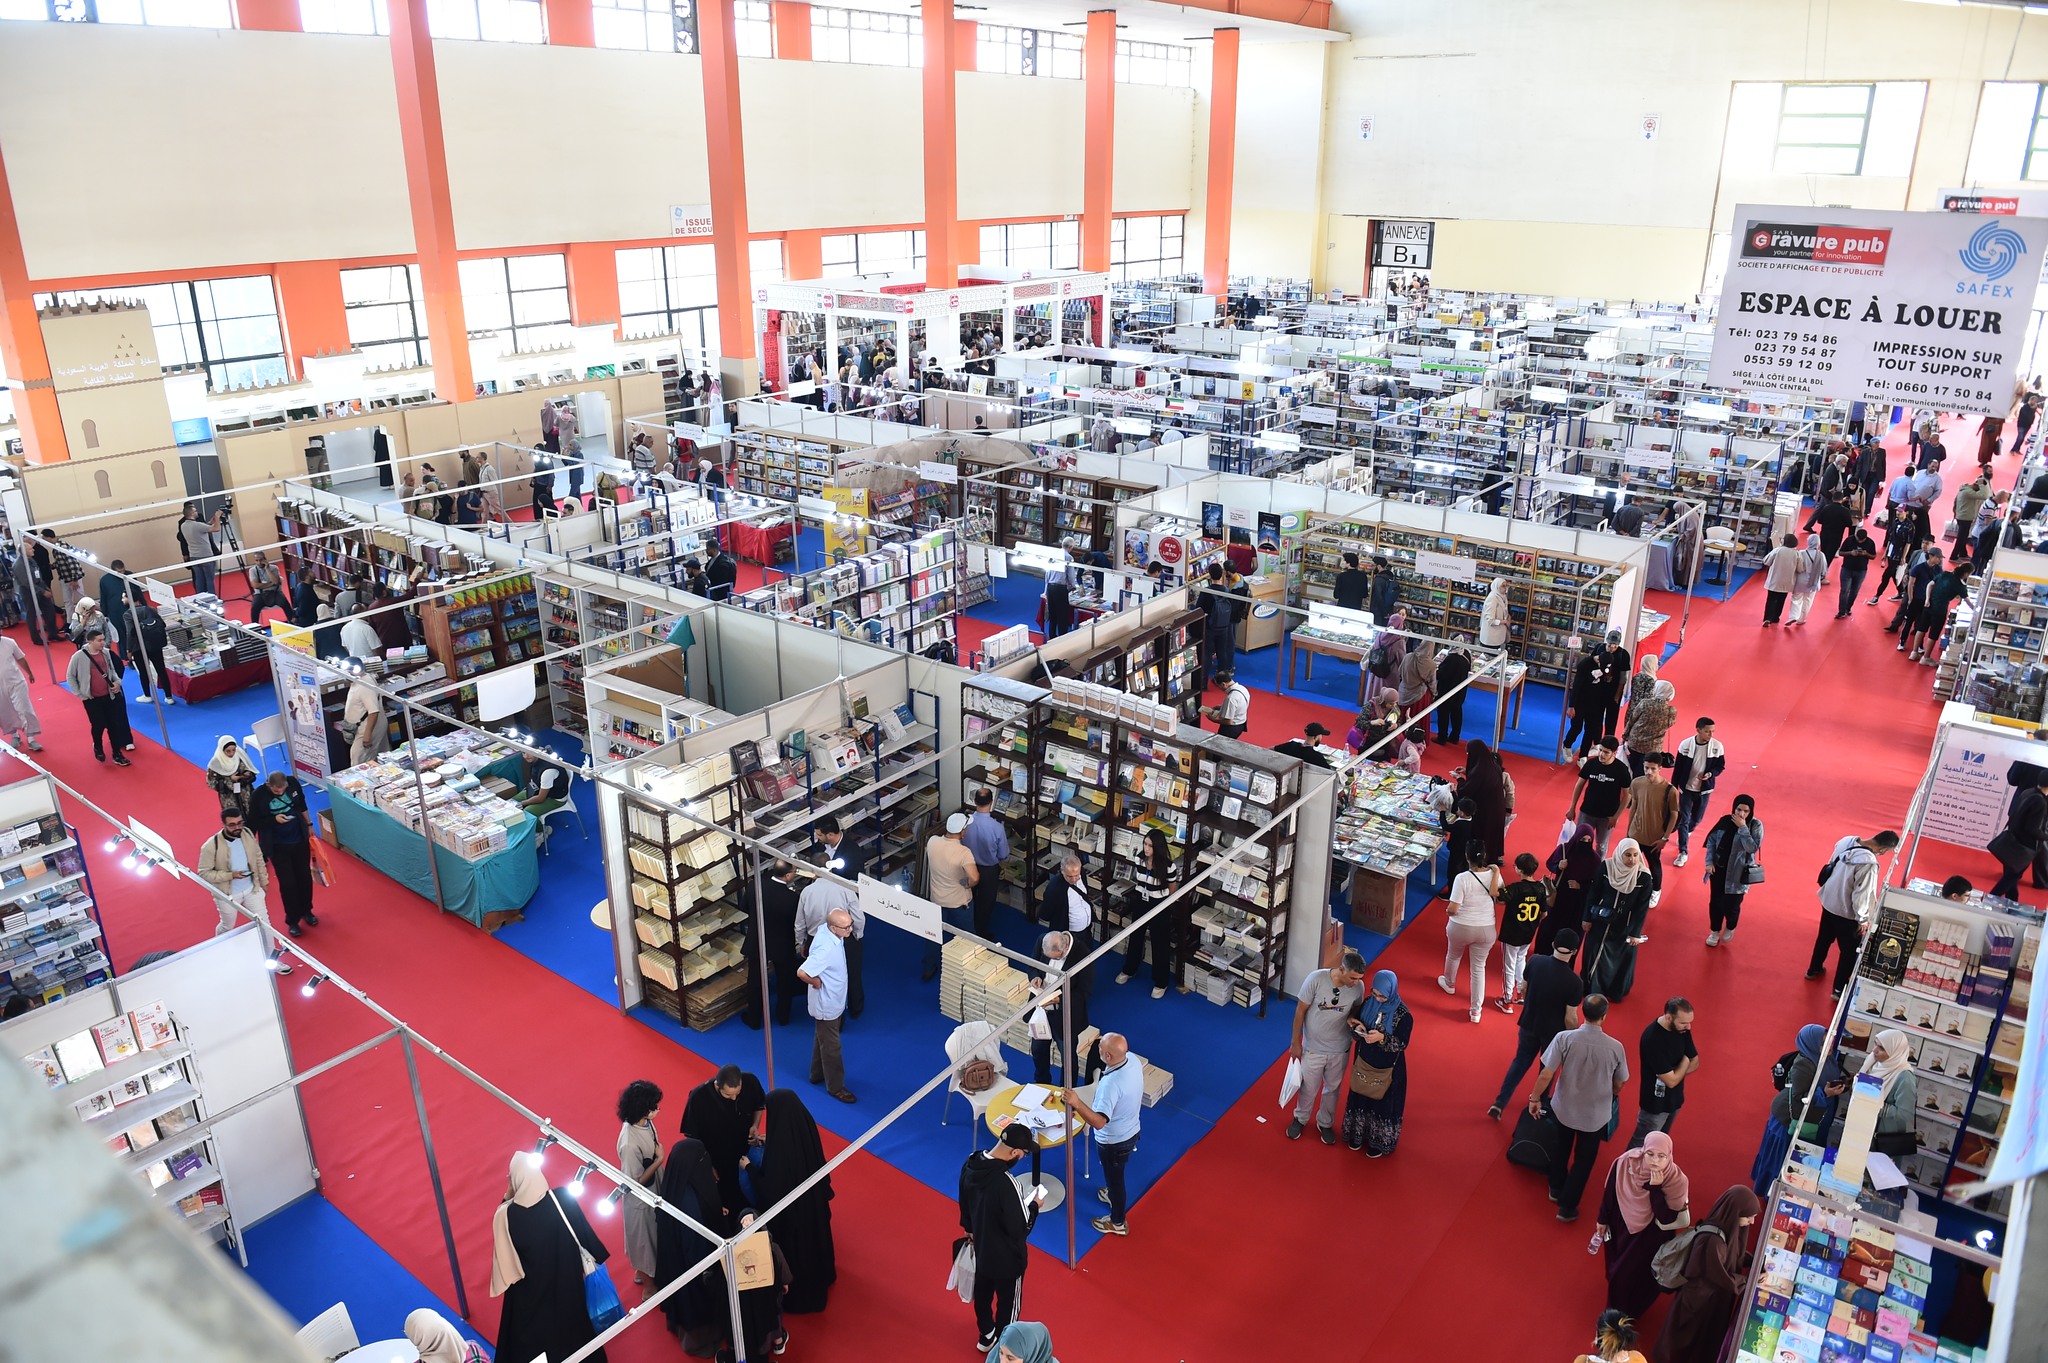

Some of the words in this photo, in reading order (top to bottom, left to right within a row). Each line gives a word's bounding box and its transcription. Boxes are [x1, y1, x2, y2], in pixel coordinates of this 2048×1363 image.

[1995, 202, 2016, 211] pub
[686, 218, 711, 226] ISSUE
[1385, 226, 1427, 240] ANNEXE
[1755, 233, 1838, 250] Gravure
[1842, 236, 1885, 254] pub
[1789, 250, 1814, 258] partner
[1770, 263, 1818, 272] D'AFFICHAGE
[1844, 268, 1884, 276] PUBLICITE
[1956, 282, 2014, 298] SAFEX
[1738, 292, 1851, 320] ESPACE
[1861, 295, 1882, 322] À
[1894, 304, 2001, 334] LOUER
[1729, 328, 1751, 337] Tél:
[1756, 330, 1778, 339] 023
[1784, 332, 1798, 340] 79
[1802, 334, 1817, 343] 54
[1822, 336, 1837, 344] 86
[1755, 343, 1776, 352] 023
[1782, 345, 1796, 354] 79
[1801, 347, 1816, 356] 54
[1821, 349, 1836, 358] 87
[1873, 342, 1966, 360] IMPRESSION
[1972, 351, 2002, 364] SUR
[89, 362, 108, 372] العربية
[113, 360, 135, 368] المملكة
[1744, 355, 1773, 365] 0553
[1778, 358, 1792, 367] 59
[1799, 360, 1812, 369] 12
[1817, 362, 1832, 371] 09
[1878, 358, 1916, 371] TOUT
[1921, 362, 1991, 380] SUPPORT
[57, 366, 86, 376] السعودية
[1767, 373, 1785, 381] CÔTÉ
[1742, 380, 1777, 388] PAVILLON
[1780, 384, 1810, 392] CENTRAL
[1866, 379, 1890, 389] Tél:
[1896, 382, 1928, 393] 0660
[1934, 386, 1949, 395] 17
[1954, 388, 1970, 398] 50
[1976, 390, 1992, 401] 84
[1864, 393, 1884, 401] Email
[1942, 764, 1964, 774] الحديث
[1965, 769, 1988, 778] الكتاب
[878, 898, 901, 911] المعارف
[903, 910, 920, 919] منتدى
[1517, 903, 1540, 921] 30
